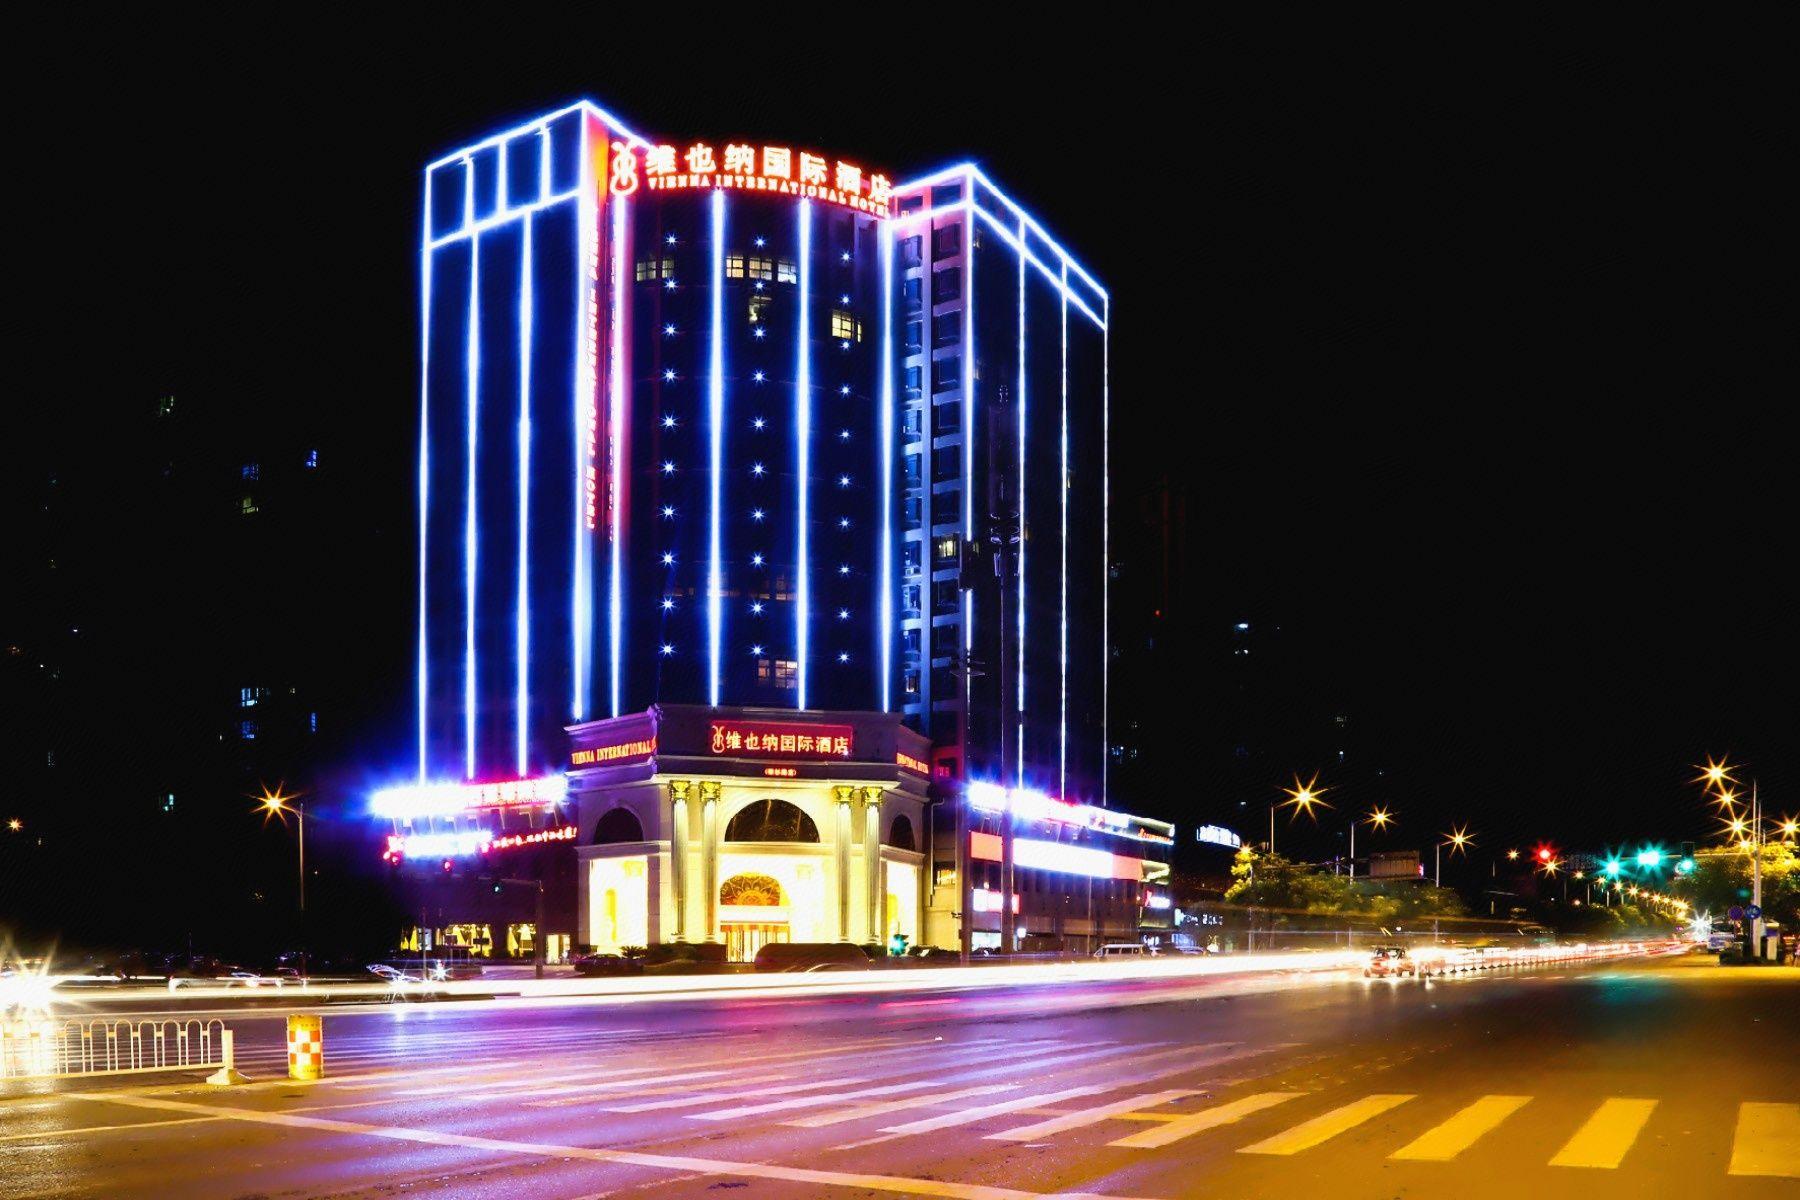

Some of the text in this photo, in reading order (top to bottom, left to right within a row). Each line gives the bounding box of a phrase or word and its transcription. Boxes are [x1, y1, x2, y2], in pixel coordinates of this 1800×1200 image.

[645, 143, 892, 207] 维也纳国际酒店
[648, 174, 711, 189] VIENNA
[715, 174, 847, 205] INTERNATIONAL
[596, 740, 652, 762] INTERNATIONAL
[726, 730, 849, 755] 维也纳国际酒店
